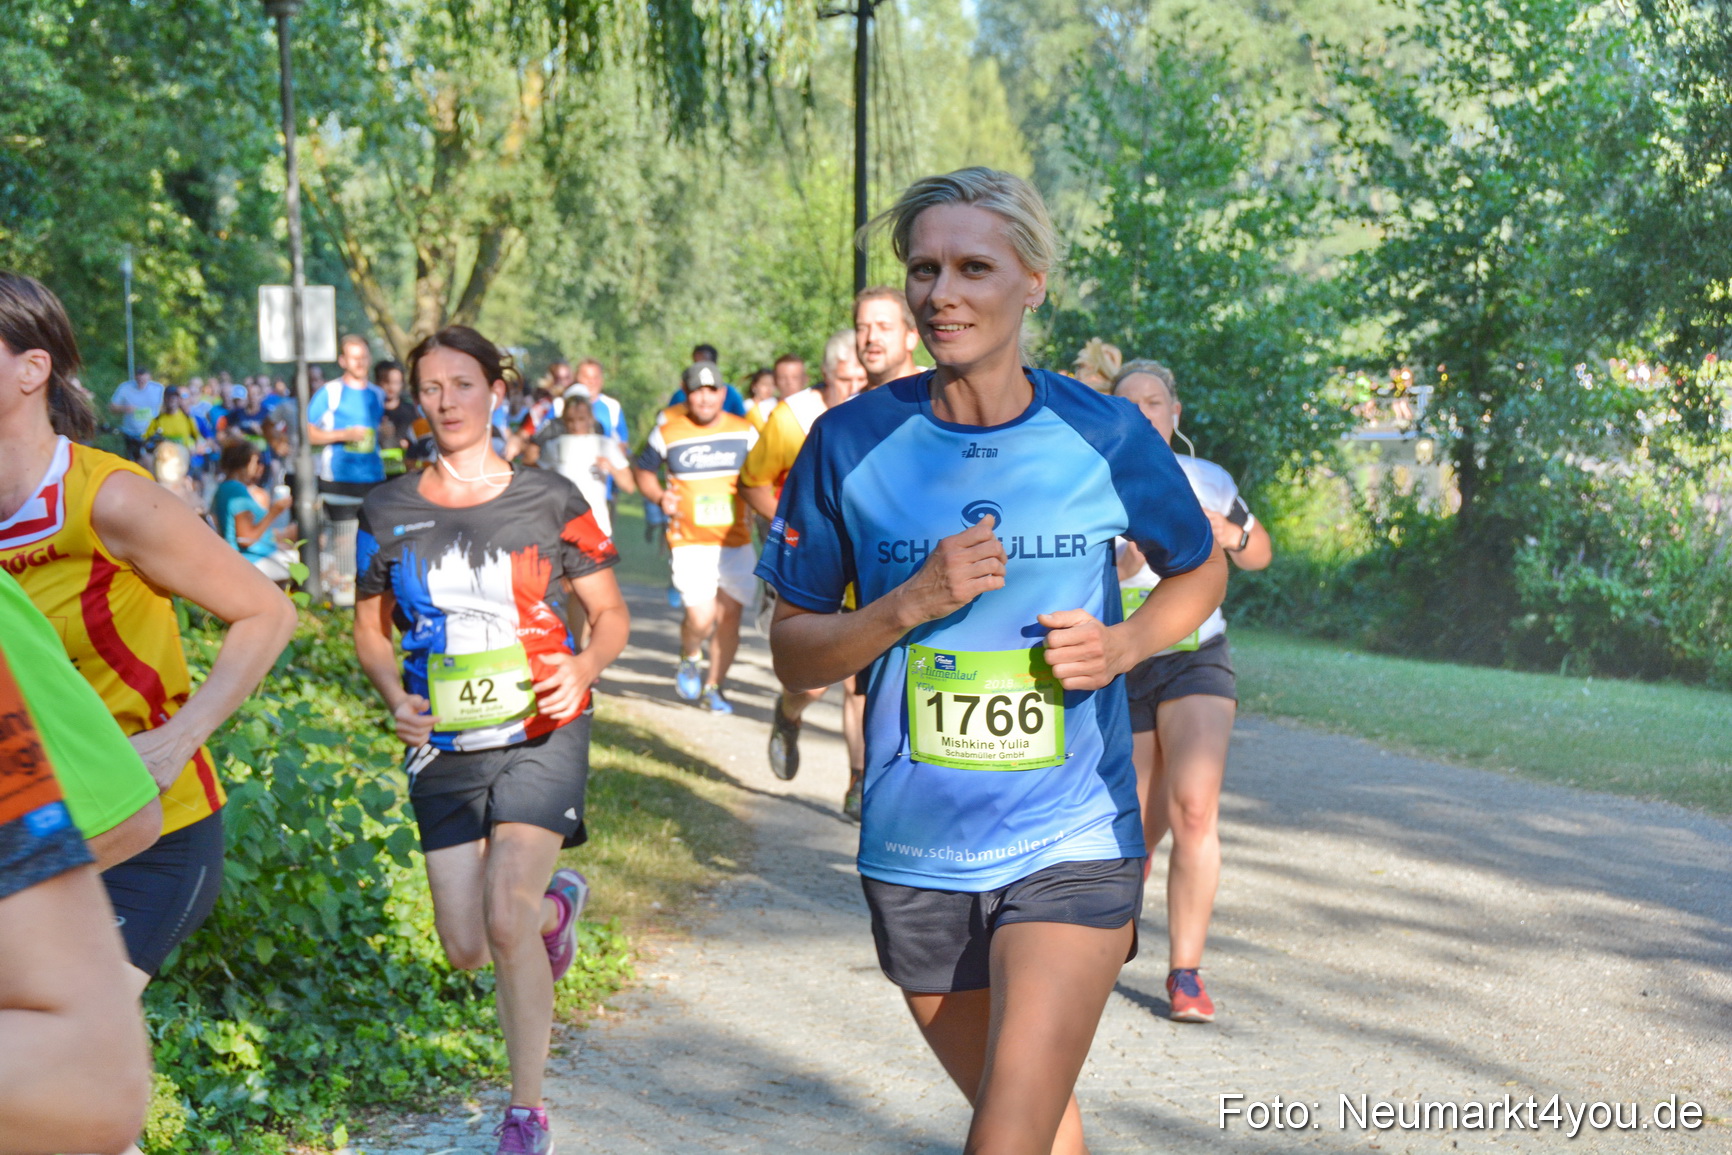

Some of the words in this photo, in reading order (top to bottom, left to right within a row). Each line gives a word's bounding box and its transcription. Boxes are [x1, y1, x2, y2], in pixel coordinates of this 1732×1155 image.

[877, 533, 1088, 564] SCHÜLLER
[925, 665, 978, 681] firmenlauf
[459, 678, 498, 705] 42
[983, 678, 1015, 690] 2018
[926, 691, 1044, 737] 1766
[941, 736, 995, 750] Mishkine
[999, 739, 1030, 750] Yulia
[945, 749, 997, 760] Schabmüller
[999, 751, 1025, 760] GmbH
[884, 830, 1065, 863] www.schabmueller.d
